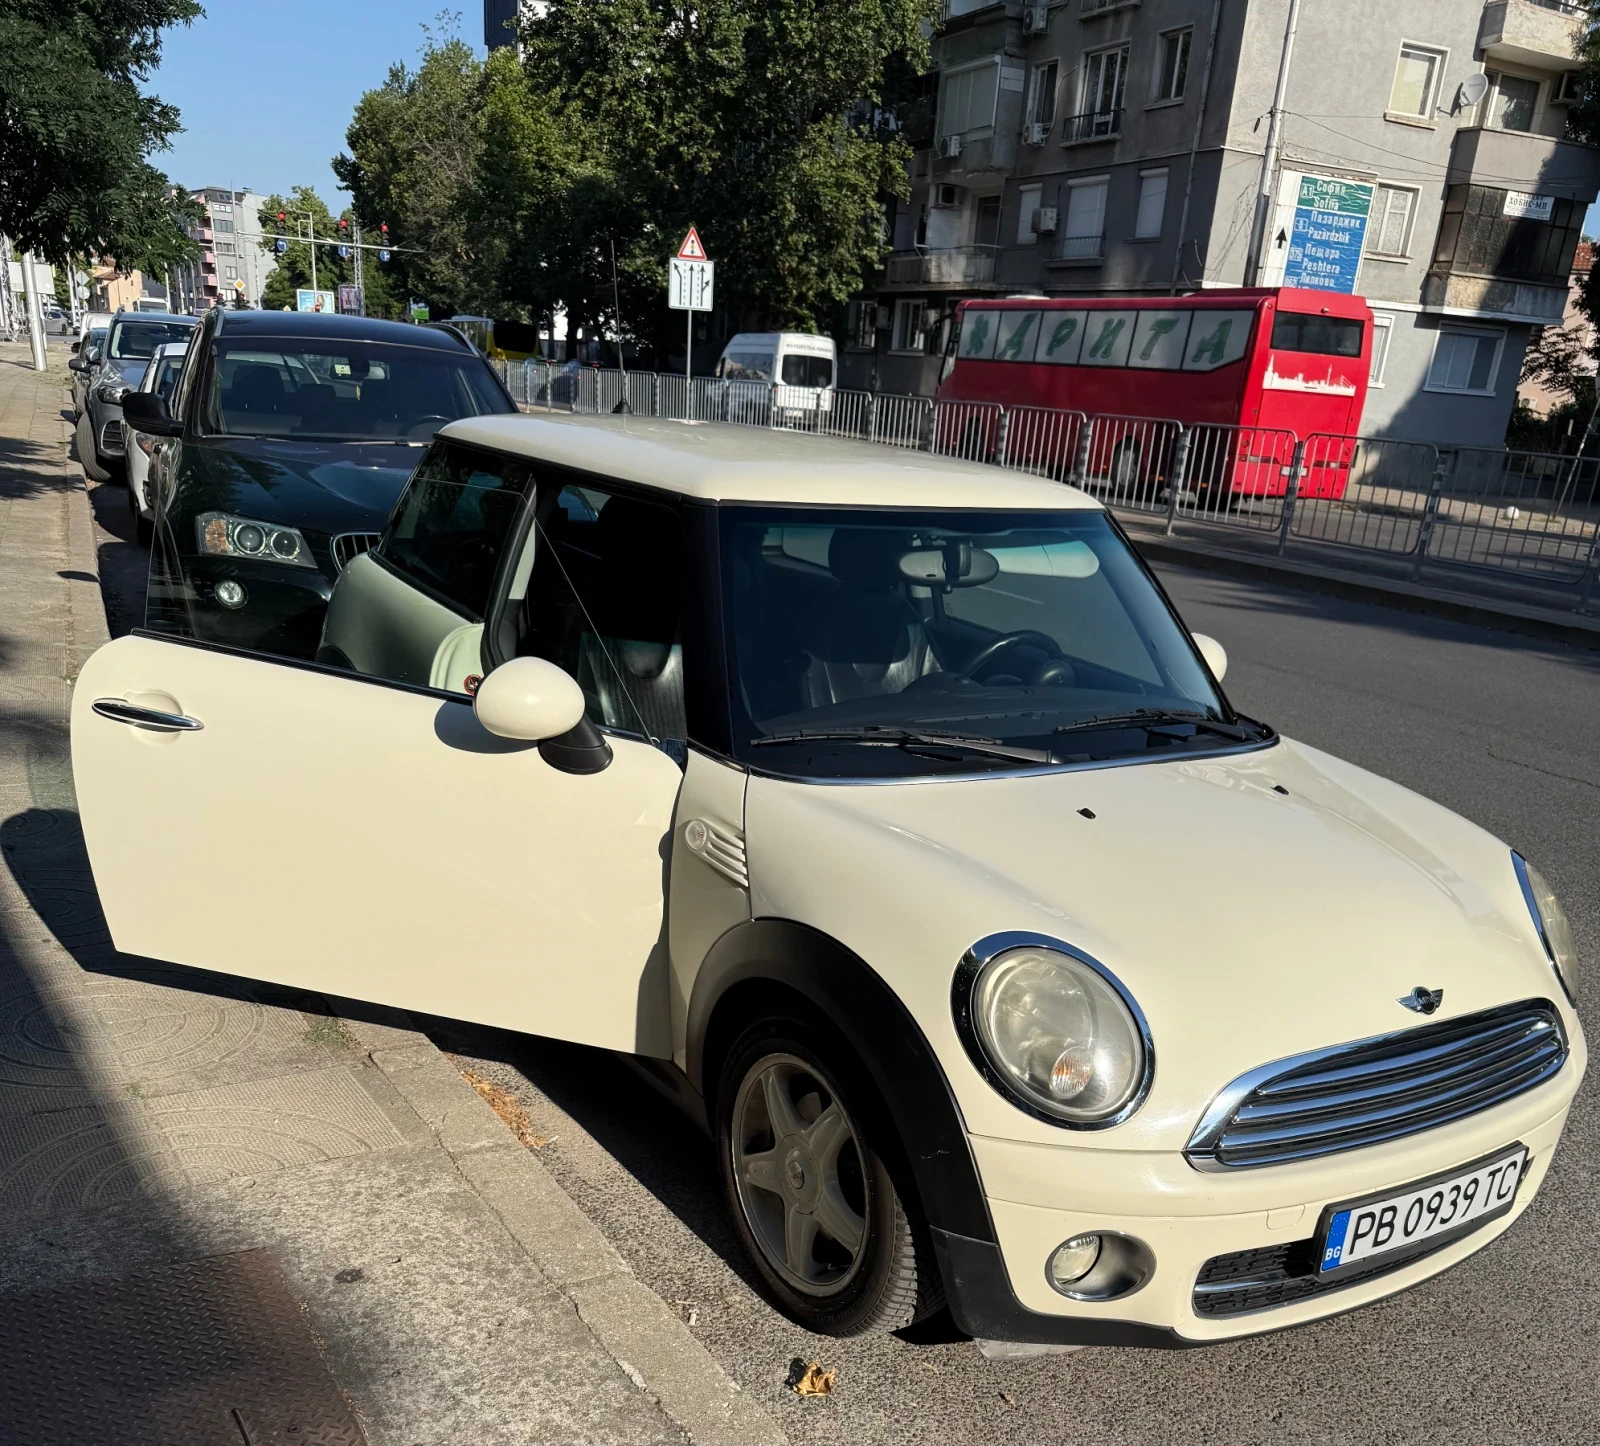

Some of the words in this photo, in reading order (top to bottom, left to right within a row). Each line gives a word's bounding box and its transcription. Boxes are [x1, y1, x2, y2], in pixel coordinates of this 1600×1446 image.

[1301, 186, 1313, 197] A1
[1317, 180, 1346, 196] София
[1310, 211, 1361, 228] Пазарджик
[1307, 226, 1351, 243] Pazardzhik
[1304, 243, 1340, 260] Пещера
[1302, 258, 1340, 274] Peshtera
[1348, 1204, 1398, 1255] PB
[1403, 1177, 1479, 1238] 0939
[1483, 1160, 1518, 1208] TC
[1324, 1245, 1341, 1261] BG
